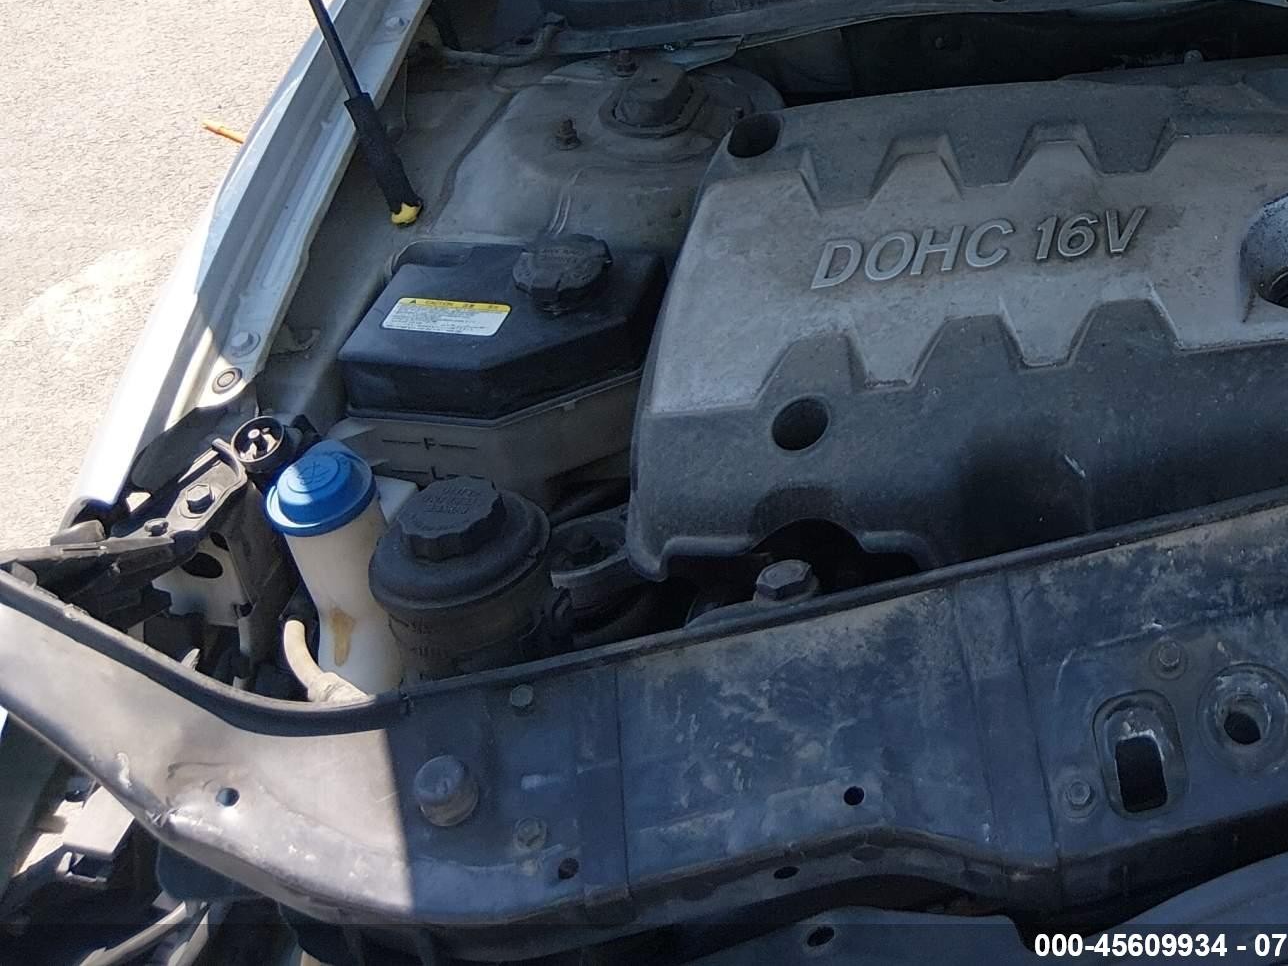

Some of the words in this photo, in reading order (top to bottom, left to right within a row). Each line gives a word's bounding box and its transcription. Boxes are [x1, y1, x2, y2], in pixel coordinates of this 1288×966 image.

[810, 218, 1015, 290] DOHC
[1036, 207, 1147, 261] 16V
[423, 437, 436, 450] F
[431, 465, 445, 481] L
